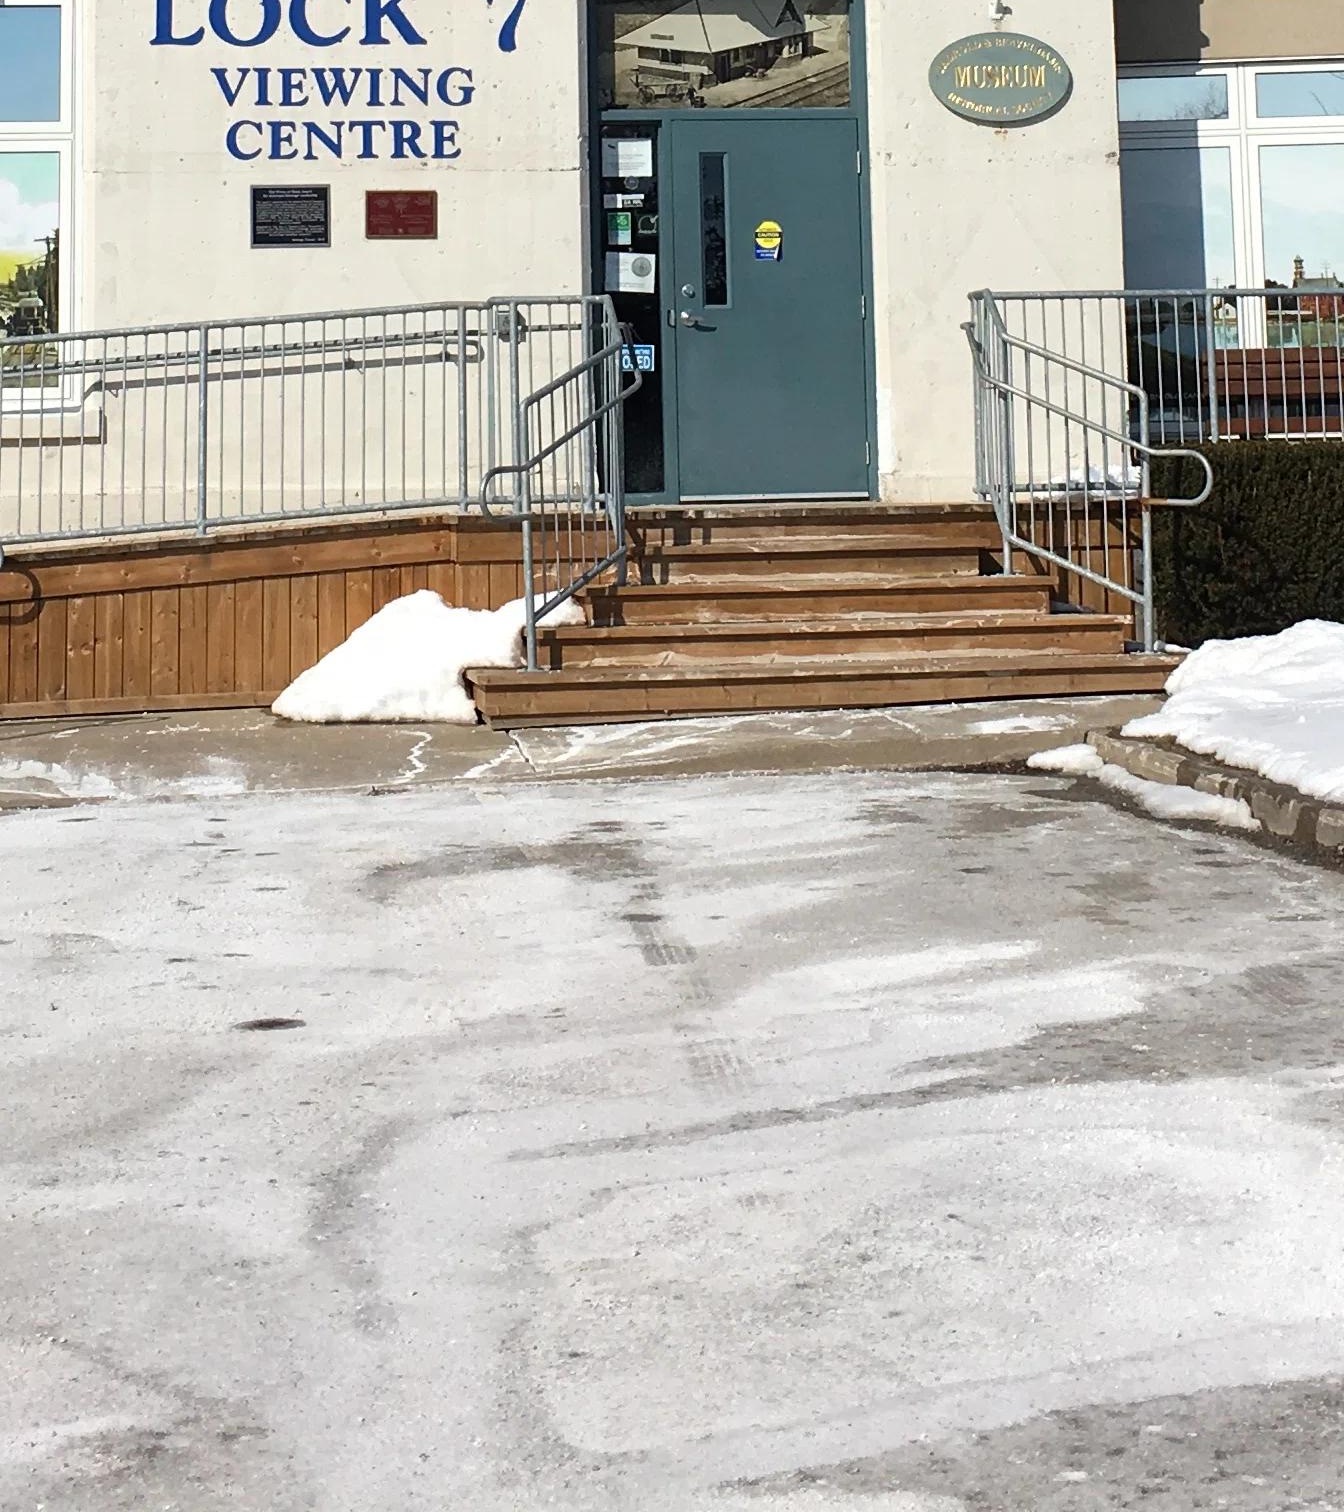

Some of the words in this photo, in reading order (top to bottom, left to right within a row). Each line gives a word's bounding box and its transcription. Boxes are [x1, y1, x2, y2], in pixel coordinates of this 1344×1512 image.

[211, 67, 475, 107] VIEWING
[955, 65, 1045, 88] MUSEUM
[225, 120, 462, 161] CENTRE
